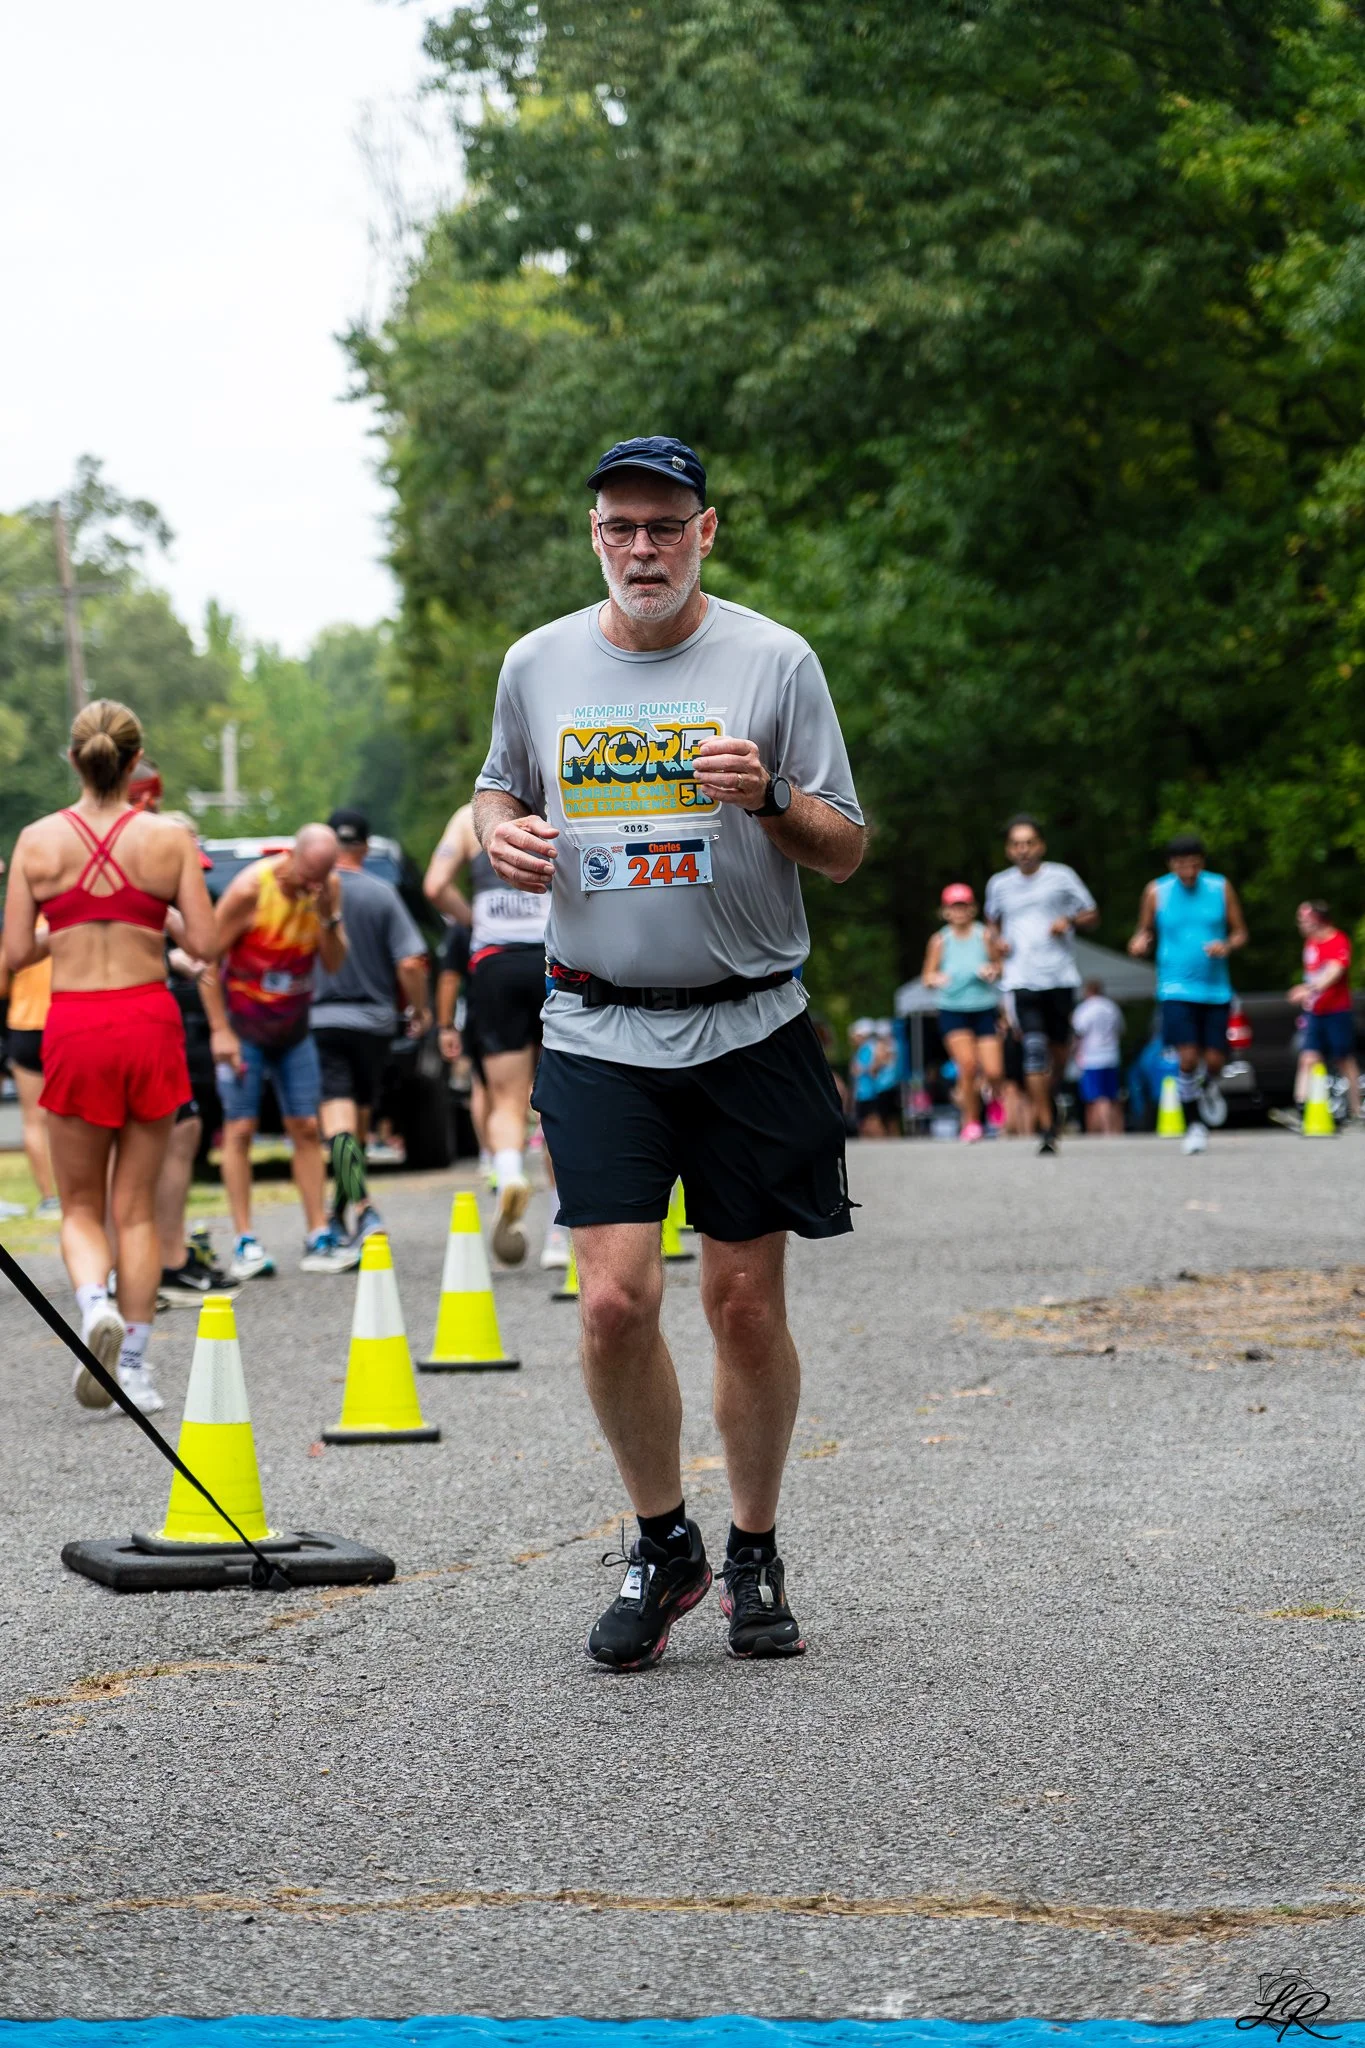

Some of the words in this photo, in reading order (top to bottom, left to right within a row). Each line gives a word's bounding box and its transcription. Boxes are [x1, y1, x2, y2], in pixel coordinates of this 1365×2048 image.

[574, 705, 634, 719] MEMPHIS
[639, 702, 706, 716] RUNNERS
[574, 719, 607, 729] TRACK
[678, 715, 706, 724] CLUB
[564, 786, 633, 801] MEMBERS
[637, 784, 677, 797] ONLY
[680, 783, 714, 806] 5K
[565, 802, 594, 813] RACE
[597, 798, 677, 812] EXPERIENCE
[623, 824, 650, 833] 2025
[648, 842, 681, 853] Charles
[628, 854, 700, 886] 244
